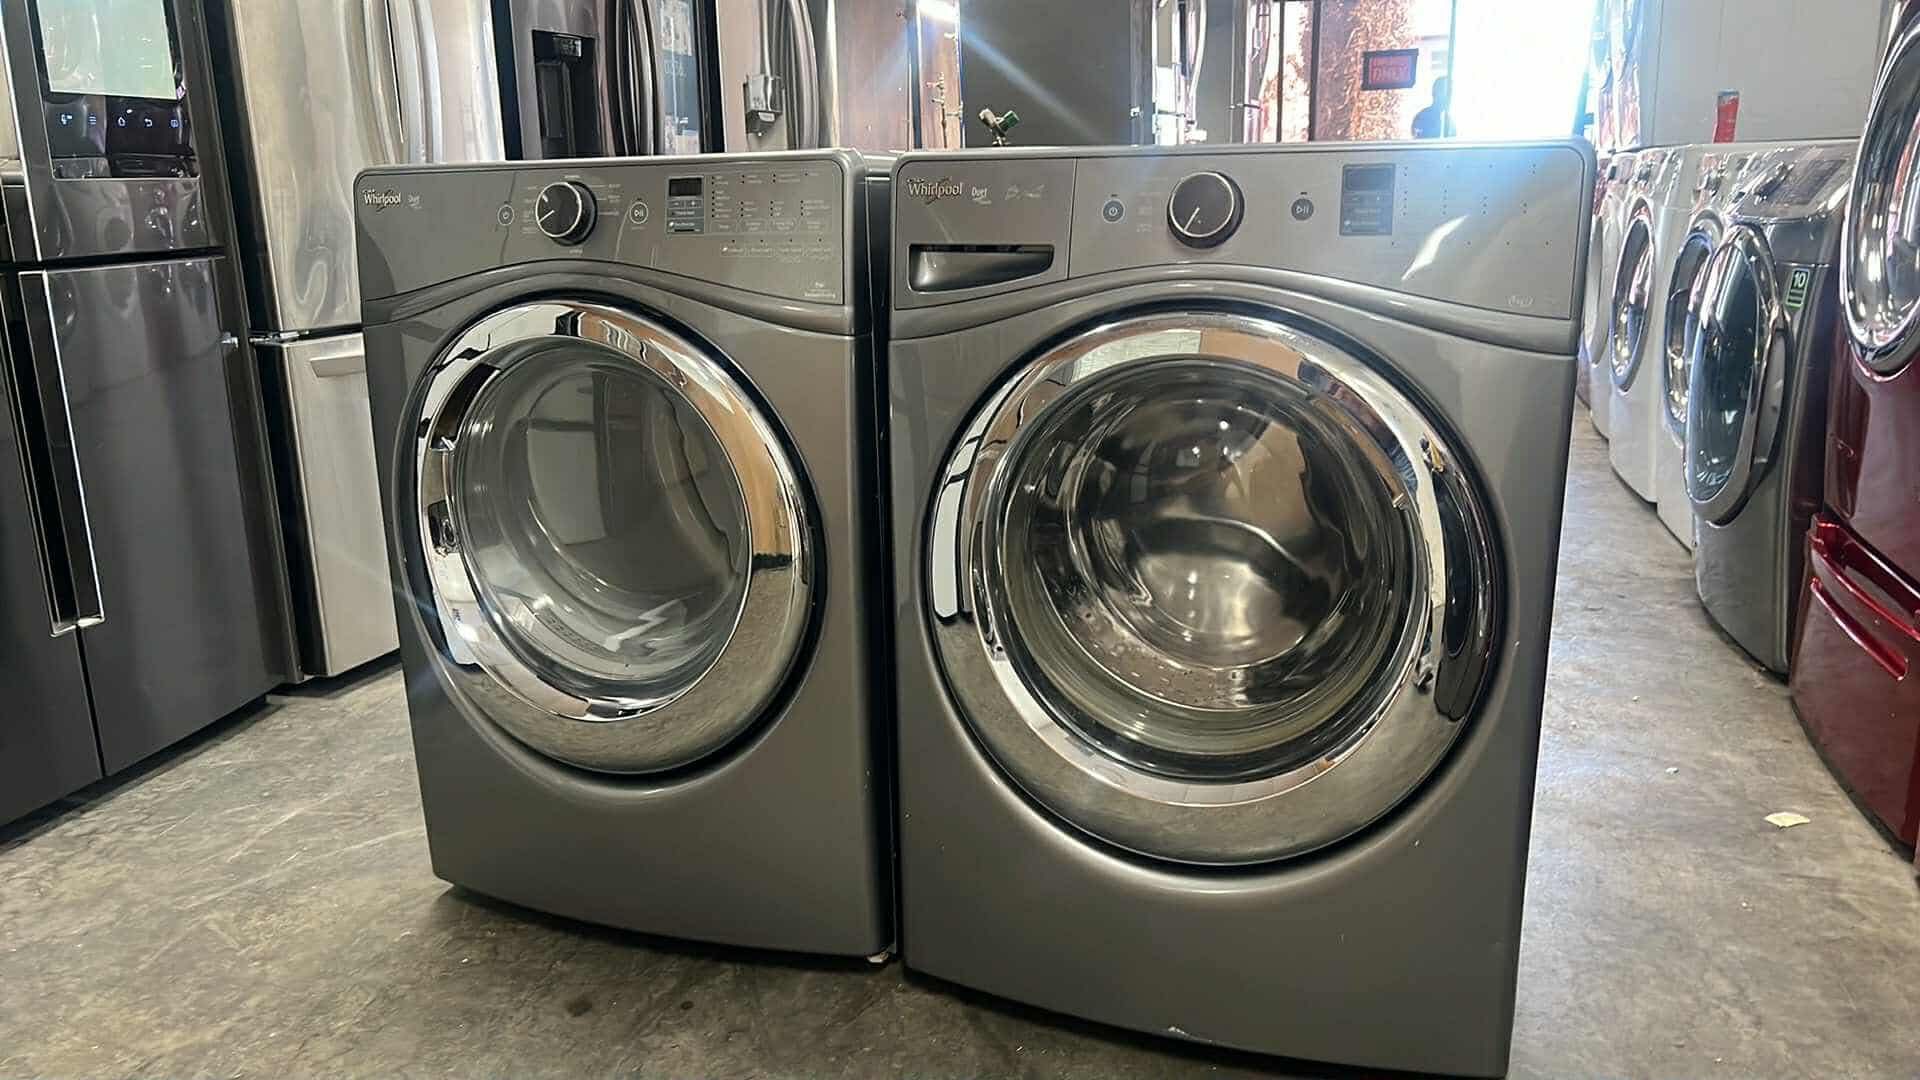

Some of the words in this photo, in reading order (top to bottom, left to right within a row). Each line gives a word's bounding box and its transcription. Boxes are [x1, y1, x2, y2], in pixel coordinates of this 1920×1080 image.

[907, 181, 963, 199] Whirlpool
[364, 192, 401, 207] Whirlpool
[1794, 271, 1806, 288] 10
